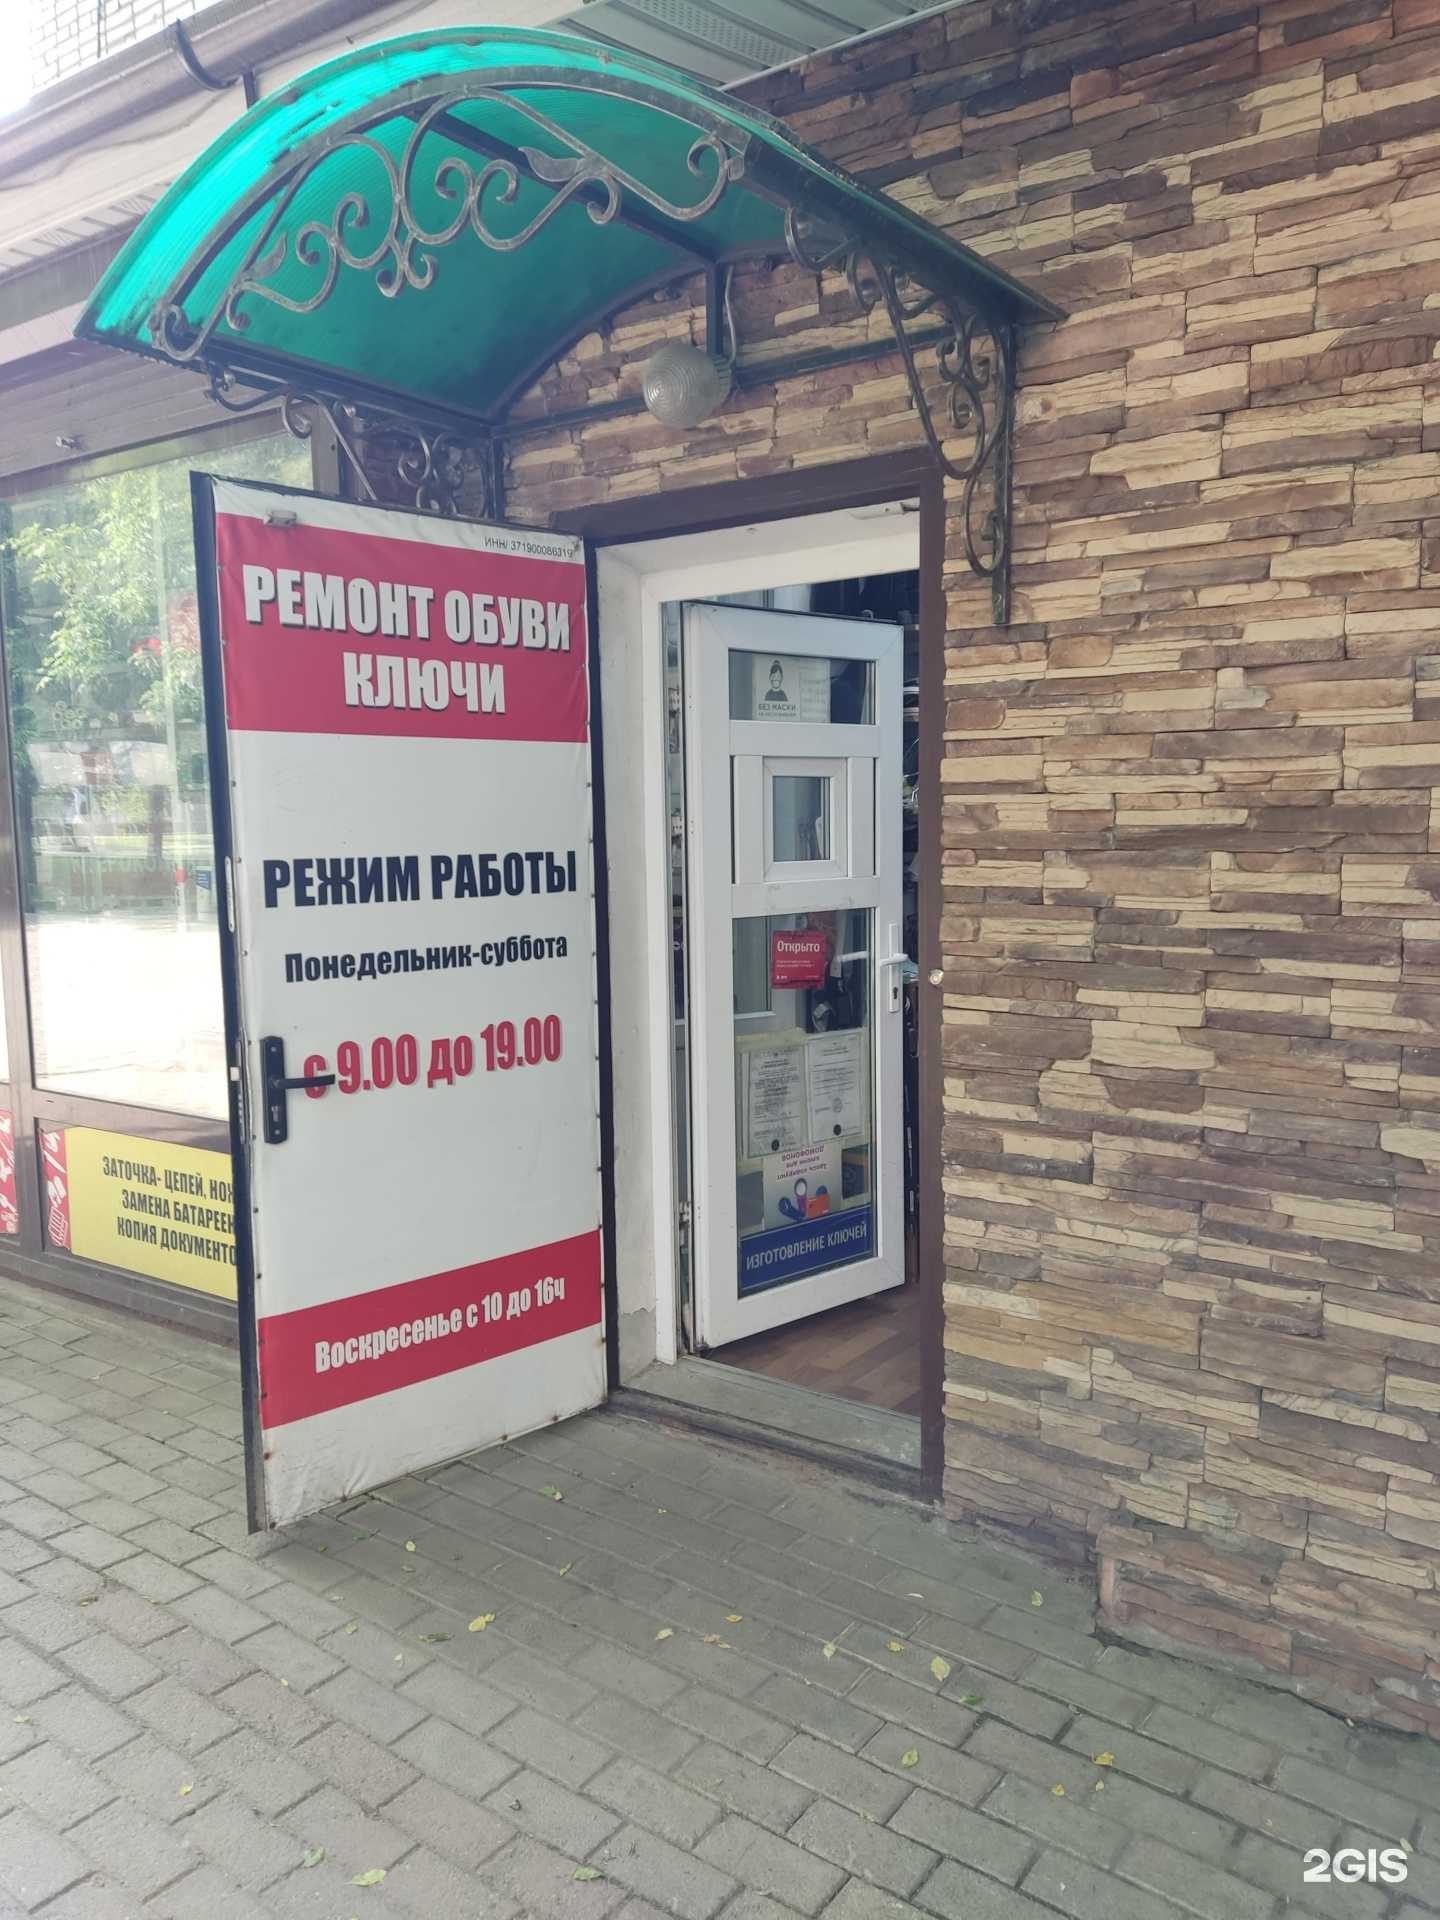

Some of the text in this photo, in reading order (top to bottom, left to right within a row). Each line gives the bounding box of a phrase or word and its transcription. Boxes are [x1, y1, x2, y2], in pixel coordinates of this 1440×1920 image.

[242, 563, 571, 652] РЕМОНТ ОБУВИ
[343, 651, 506, 714] КЛЮЧИ
[263, 850, 577, 908] РЕЖИМ РАБОТЫ
[285, 935, 568, 983] Понедельник-суббота
[776, 939, 820, 955] Открыто
[336, 1033, 419, 1094] 9.00
[427, 1035, 474, 1088] до
[480, 1014, 562, 1072] 19.00
[102, 1155, 161, 1187] ЗАТОЧКА-
[163, 1169, 207, 1199] ЦЕПЕЙ,
[121, 1188, 171, 1219] ЗАМЕНА
[116, 1215, 157, 1245] КОПИЯ
[745, 1222, 867, 1271] ИЗГОТОВЛЕНИЕ КЛЮЧЕЙ
[313, 1275, 566, 1374] Воскресенье с 10 до 16ч
